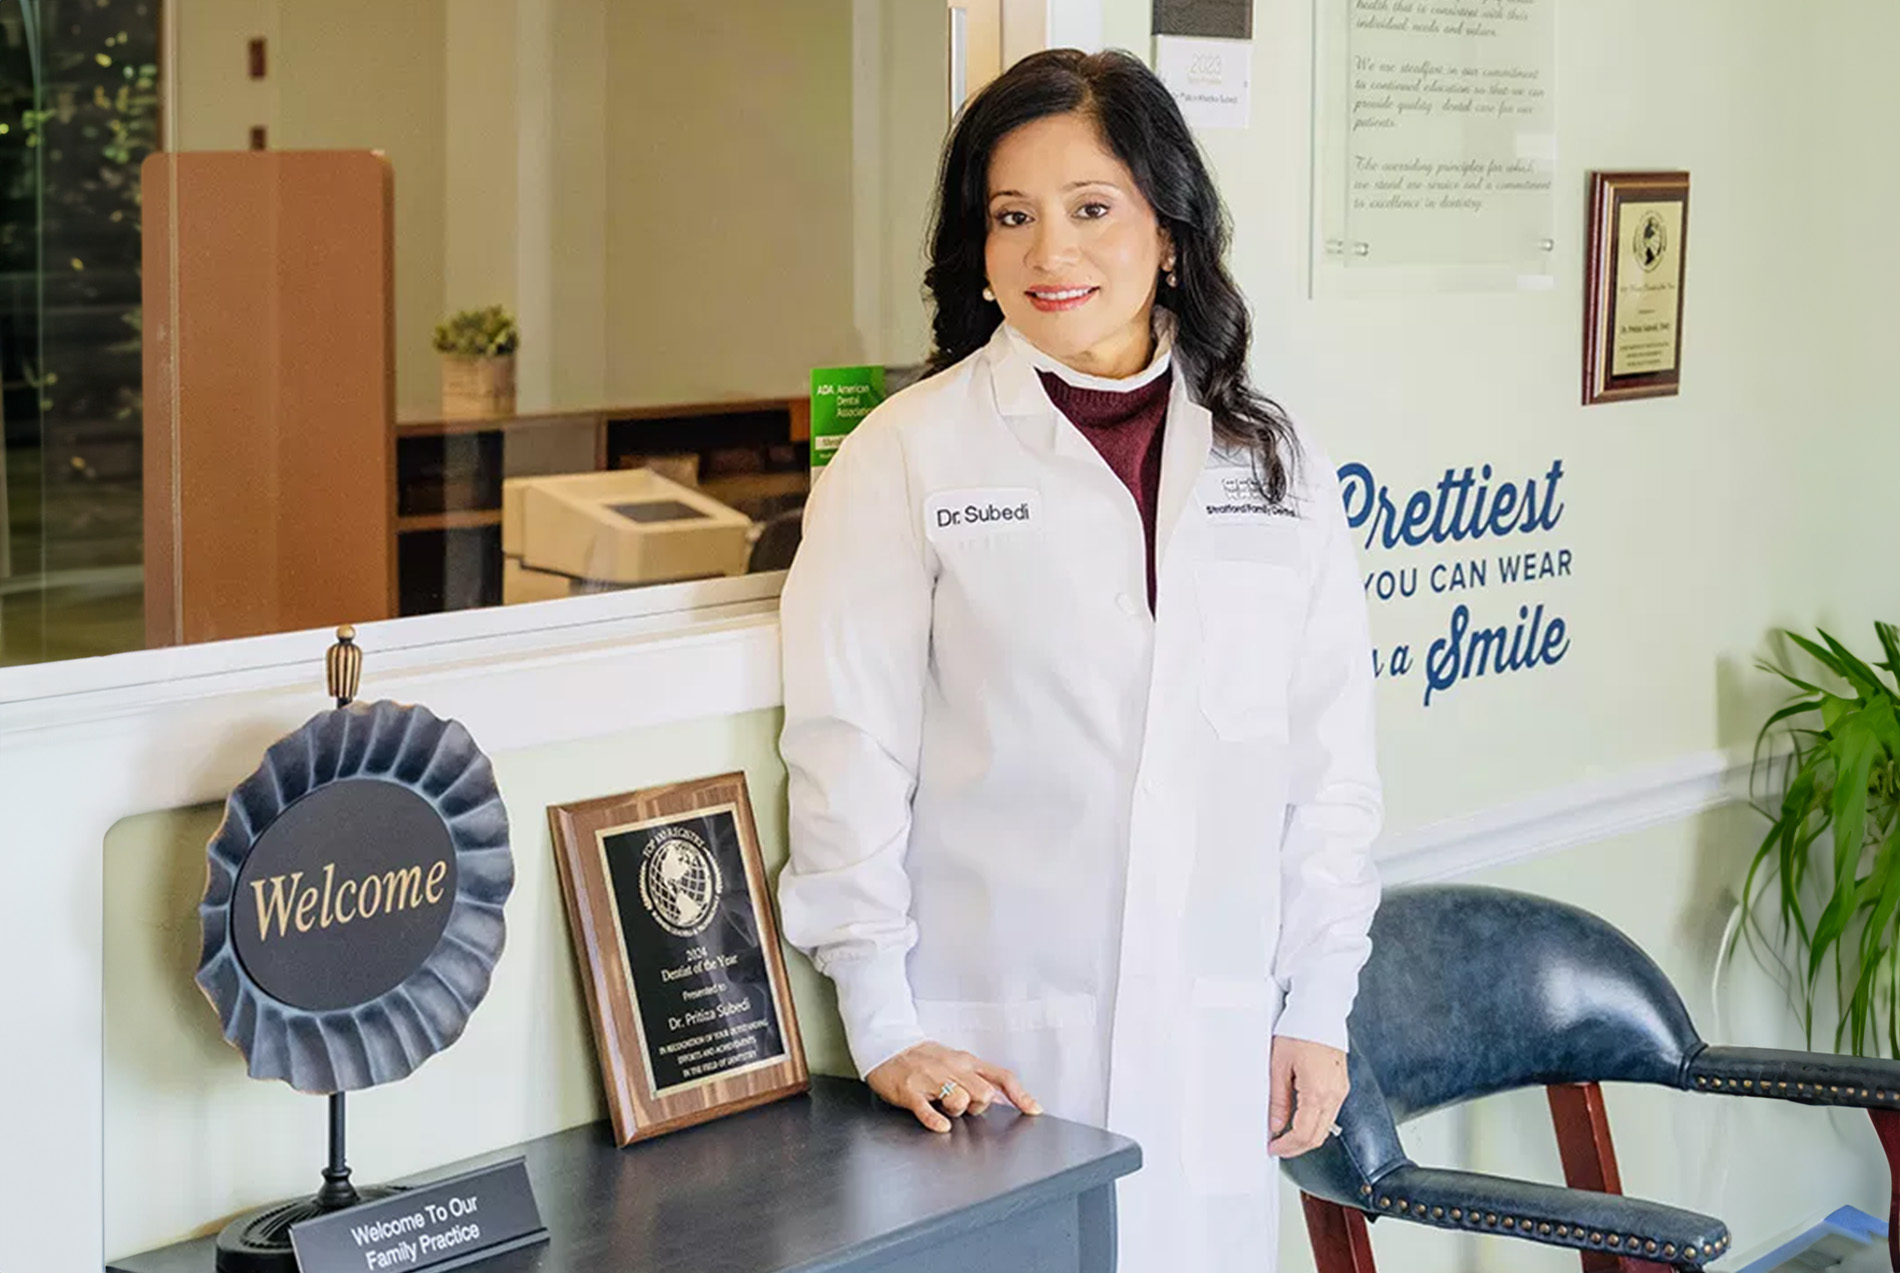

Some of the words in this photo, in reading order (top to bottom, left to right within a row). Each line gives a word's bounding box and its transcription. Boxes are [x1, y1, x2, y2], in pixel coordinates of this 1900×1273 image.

[1355, 55, 1375, 71] We
[1355, 155, 1378, 172] The
[817, 384, 835, 396] ADA
[837, 384, 870, 395] American
[837, 396, 860, 406] Dental
[937, 509, 960, 528] Dr.
[964, 503, 1029, 523] Subedi
[1337, 459, 1564, 549] Prettiest
[1430, 559, 1486, 592] CAN
[1499, 549, 1573, 583] WEAR
[1390, 645, 1413, 677] a
[1423, 604, 1570, 707] Smile
[250, 859, 447, 942] Welcome
[661, 965, 693, 982] Dentist
[693, 960, 703, 973] of
[703, 959, 717, 972] the
[716, 954, 738, 968] Year
[682, 983, 720, 1001] Presented
[720, 983, 728, 992] to
[668, 1017, 685, 1031] Dr.
[716, 997, 751, 1017] Subedi
[351, 1213, 425, 1247] Welcome
[424, 1204, 448, 1224] To
[449, 1196, 477, 1218] Our
[365, 1241, 417, 1271] Family
[418, 1223, 480, 1254] Practice
